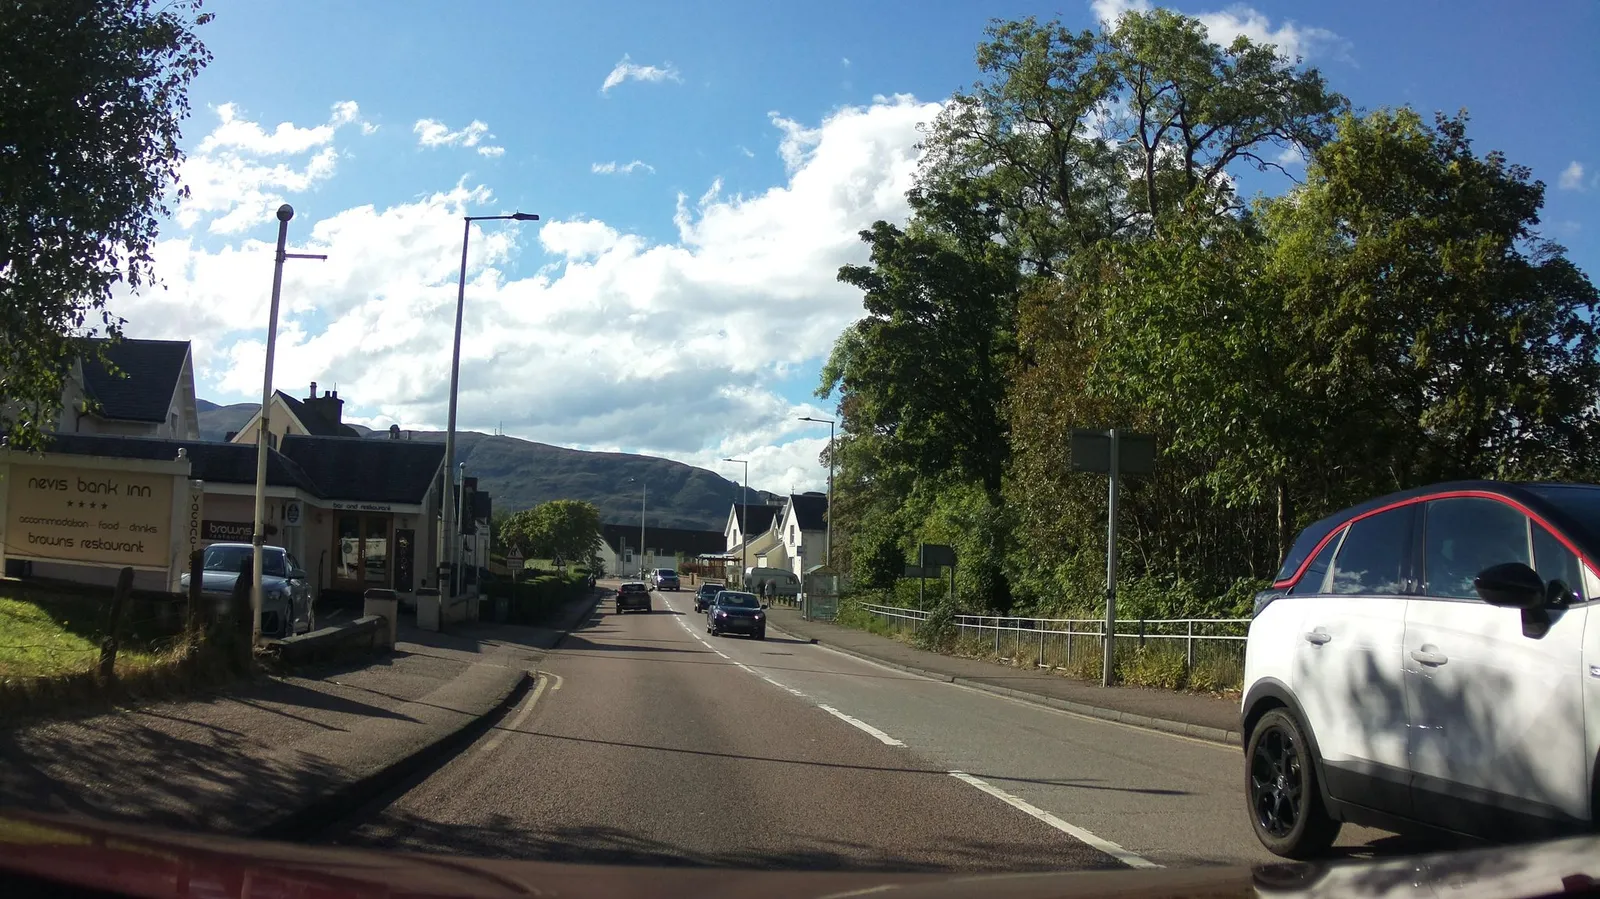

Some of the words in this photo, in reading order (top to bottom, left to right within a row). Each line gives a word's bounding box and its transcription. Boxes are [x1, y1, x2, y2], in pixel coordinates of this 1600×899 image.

[28, 477, 68, 491] nevis
[77, 477, 118, 496] bank
[127, 484, 152, 498] inn
[19, 515, 89, 528] accommodation
[98, 520, 119, 531] food
[129, 522, 158, 534] drinks
[209, 522, 253, 536] browns
[28, 532, 74, 547] browns
[81, 538, 144, 553] restaurant
